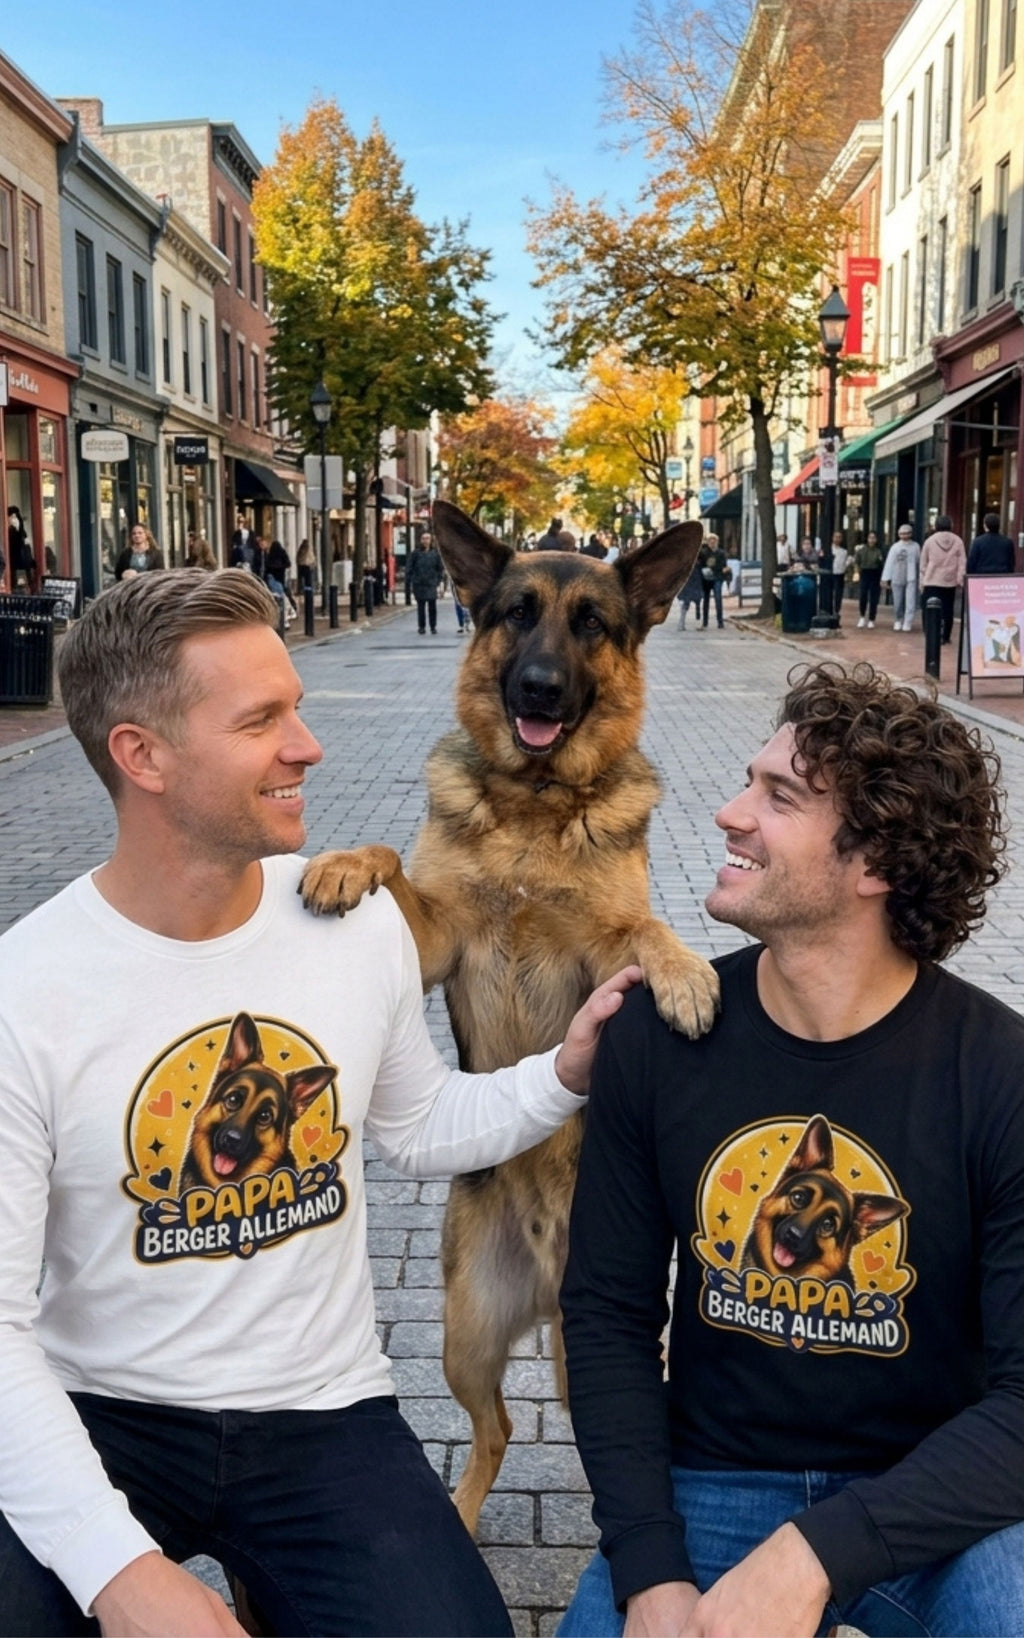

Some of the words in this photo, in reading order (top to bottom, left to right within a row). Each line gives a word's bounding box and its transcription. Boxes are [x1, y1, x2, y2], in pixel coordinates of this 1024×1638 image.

[143, 1223, 231, 1257] BERGER
[239, 1185, 340, 1243] ALLEMAND
[186, 1170, 295, 1227] PAPA
[708, 1290, 784, 1334] BERGER
[791, 1314, 899, 1347] ALLEMAND
[745, 1271, 850, 1319] PAPA
